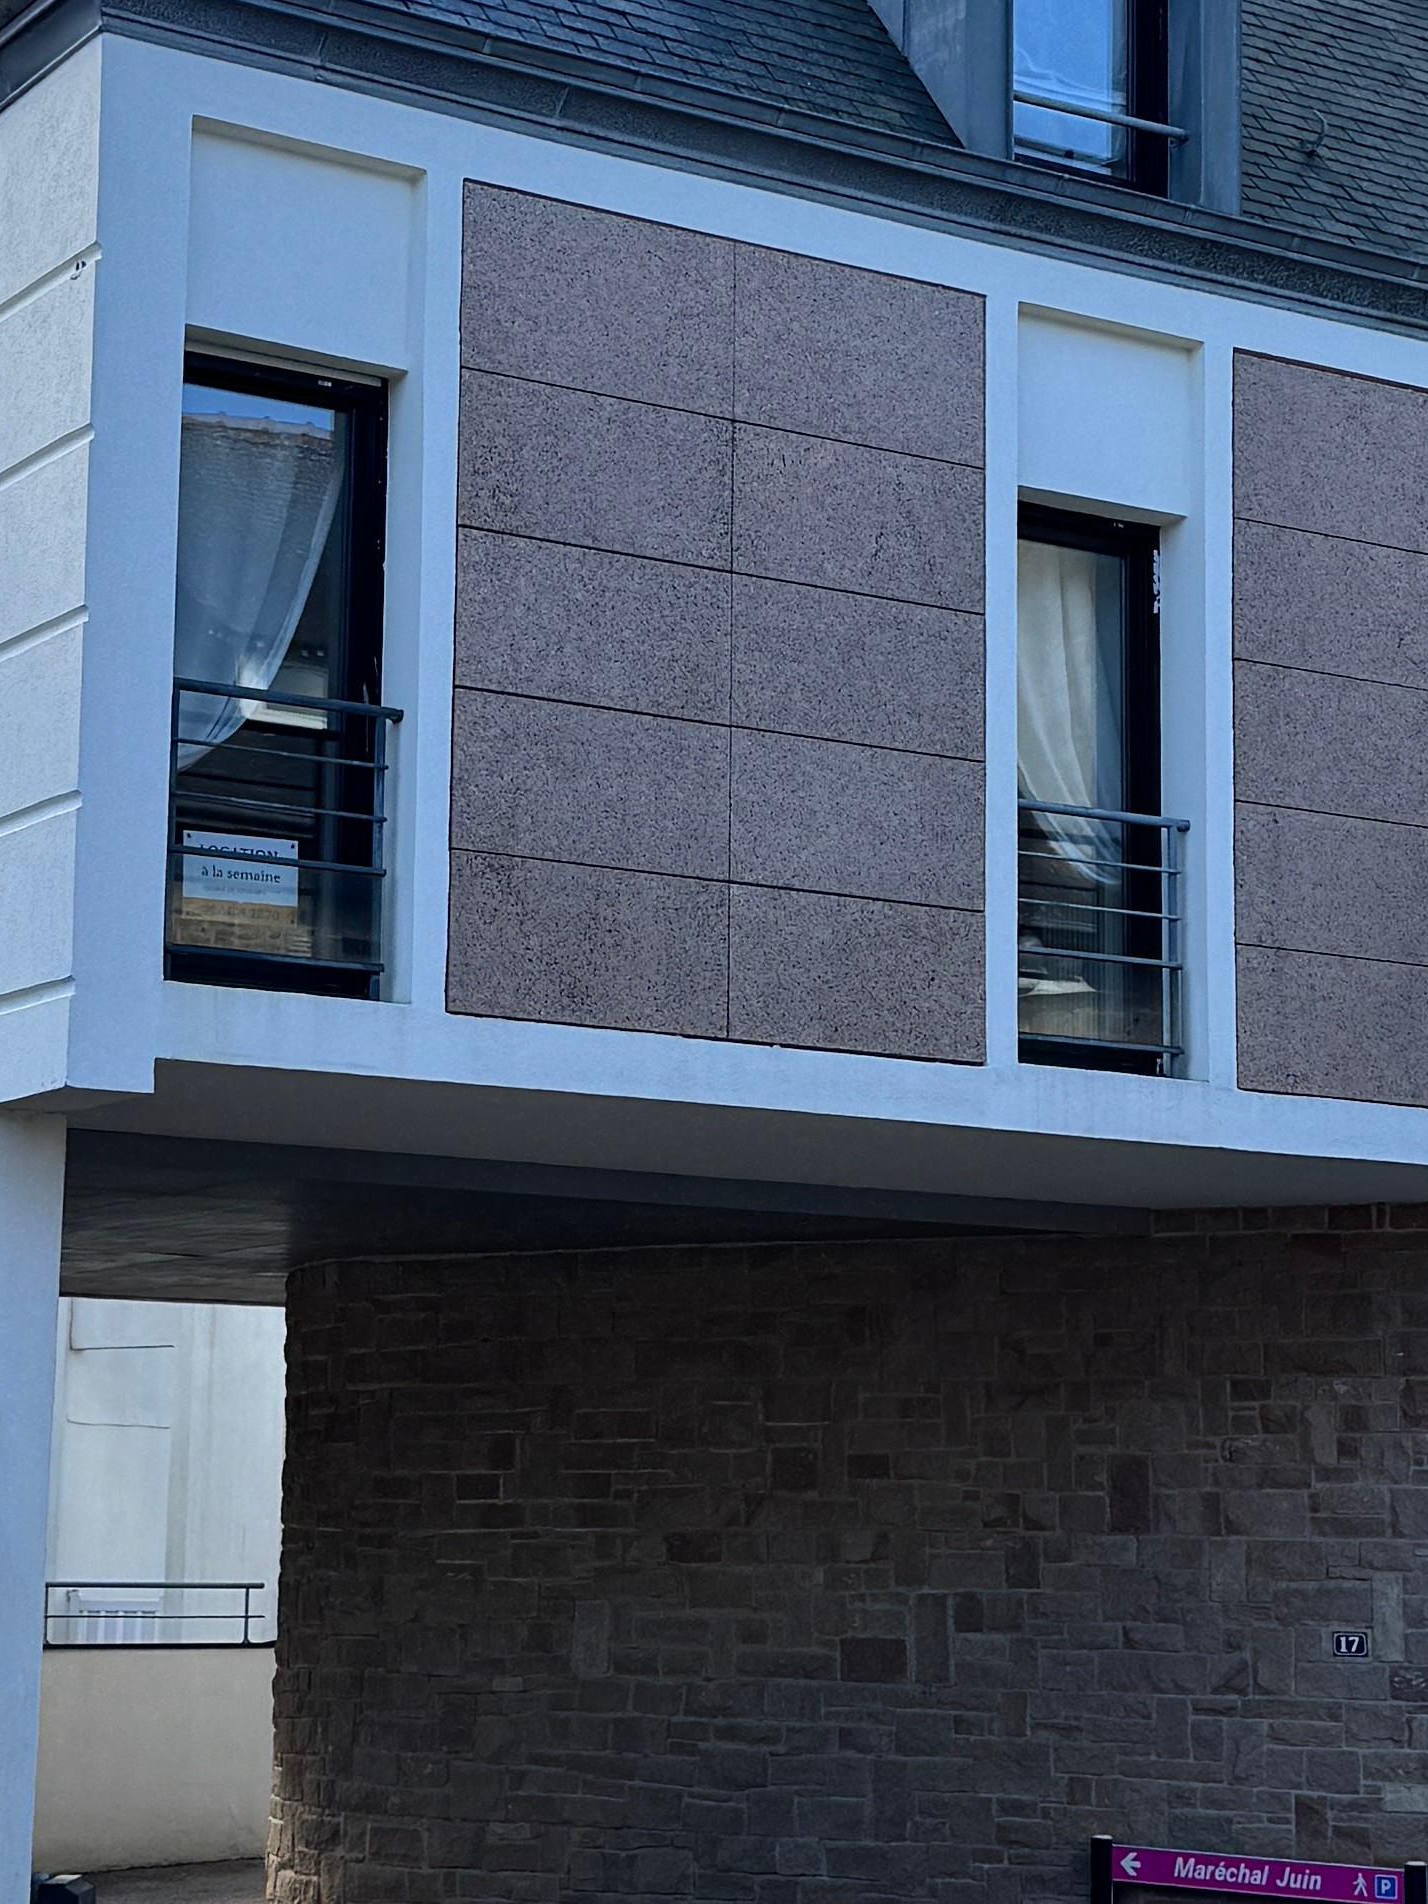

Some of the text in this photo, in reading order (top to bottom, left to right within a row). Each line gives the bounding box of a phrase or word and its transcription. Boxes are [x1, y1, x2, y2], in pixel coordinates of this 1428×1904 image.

[212, 864, 223, 877] la
[227, 869, 281, 884] semaine
[1339, 1636, 1360, 1653] 17
[1173, 1856, 1270, 1886] Maréchal
[1275, 1866, 1322, 1891] Juin
